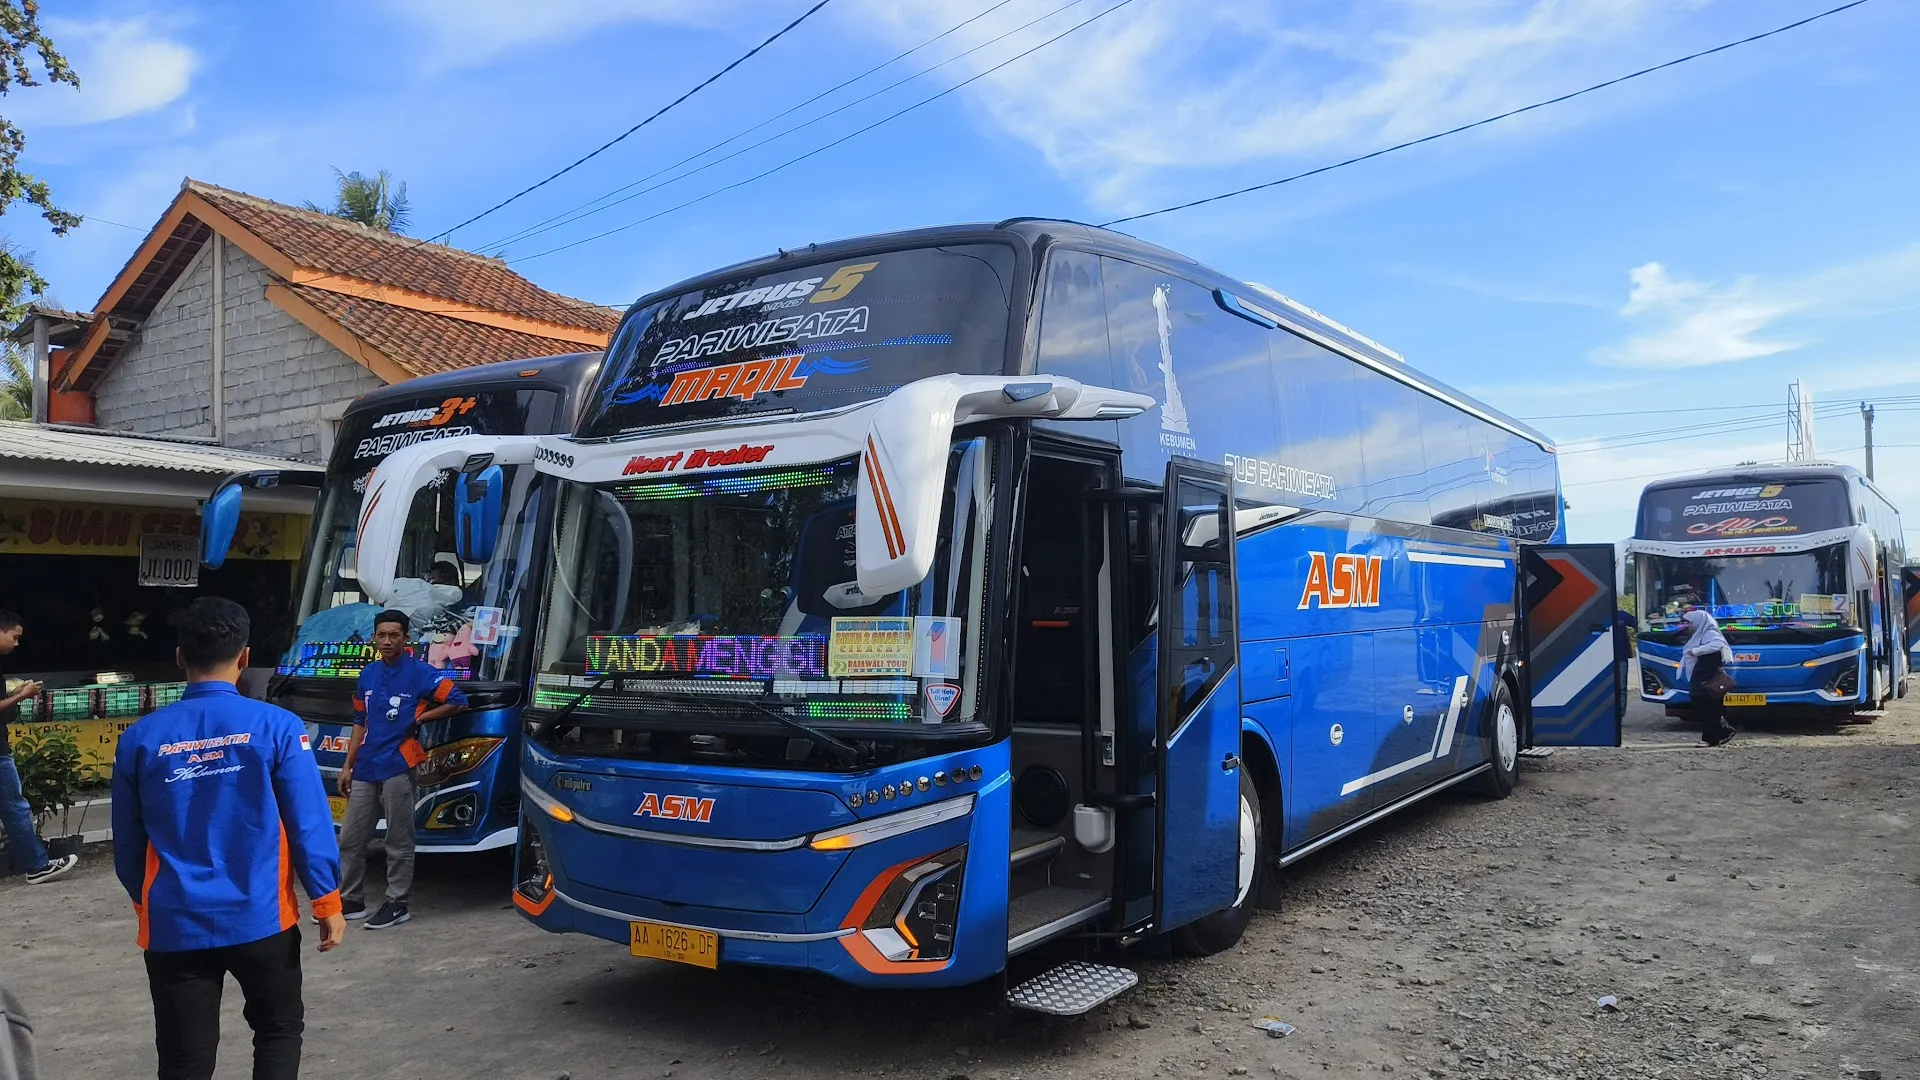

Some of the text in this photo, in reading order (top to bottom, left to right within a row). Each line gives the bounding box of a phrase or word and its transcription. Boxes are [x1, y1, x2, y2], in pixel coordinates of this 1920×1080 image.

[683, 261, 880, 320] JETBUS 5
[650, 306, 870, 368] PARIWISATA
[658, 353, 809, 408] MAQIL
[372, 395, 476, 429] JETBUS 3+
[1159, 432, 1197, 451] KEBUMEN
[622, 444, 775, 476] Heart Breaker
[1259, 461, 1337, 500] PARIWISATA
[1692, 484, 1785, 500] JETBUS 5
[1682, 499, 1793, 516] PARIWISATA
[28, 507, 249, 552] BUAH SEGR
[1704, 546, 1776, 556] AR-RAZZAQ
[1297, 550, 1383, 610] ASM
[1834, 596, 1848, 612] 2
[474, 609, 499, 641] 3
[863, 632, 871, 645] 2
[605, 638, 679, 672] ANDA
[839, 645, 905, 653] CILACAP
[926, 621, 946, 673] 1
[847, 660, 908, 668] RAJAWALI TOUR
[158, 733, 251, 757] PARIWISATA
[187, 750, 224, 764] ASM
[164, 764, 246, 783] Kebumen
[633, 792, 716, 823] ASM
[634, 924, 714, 955] AA 1626 DF
